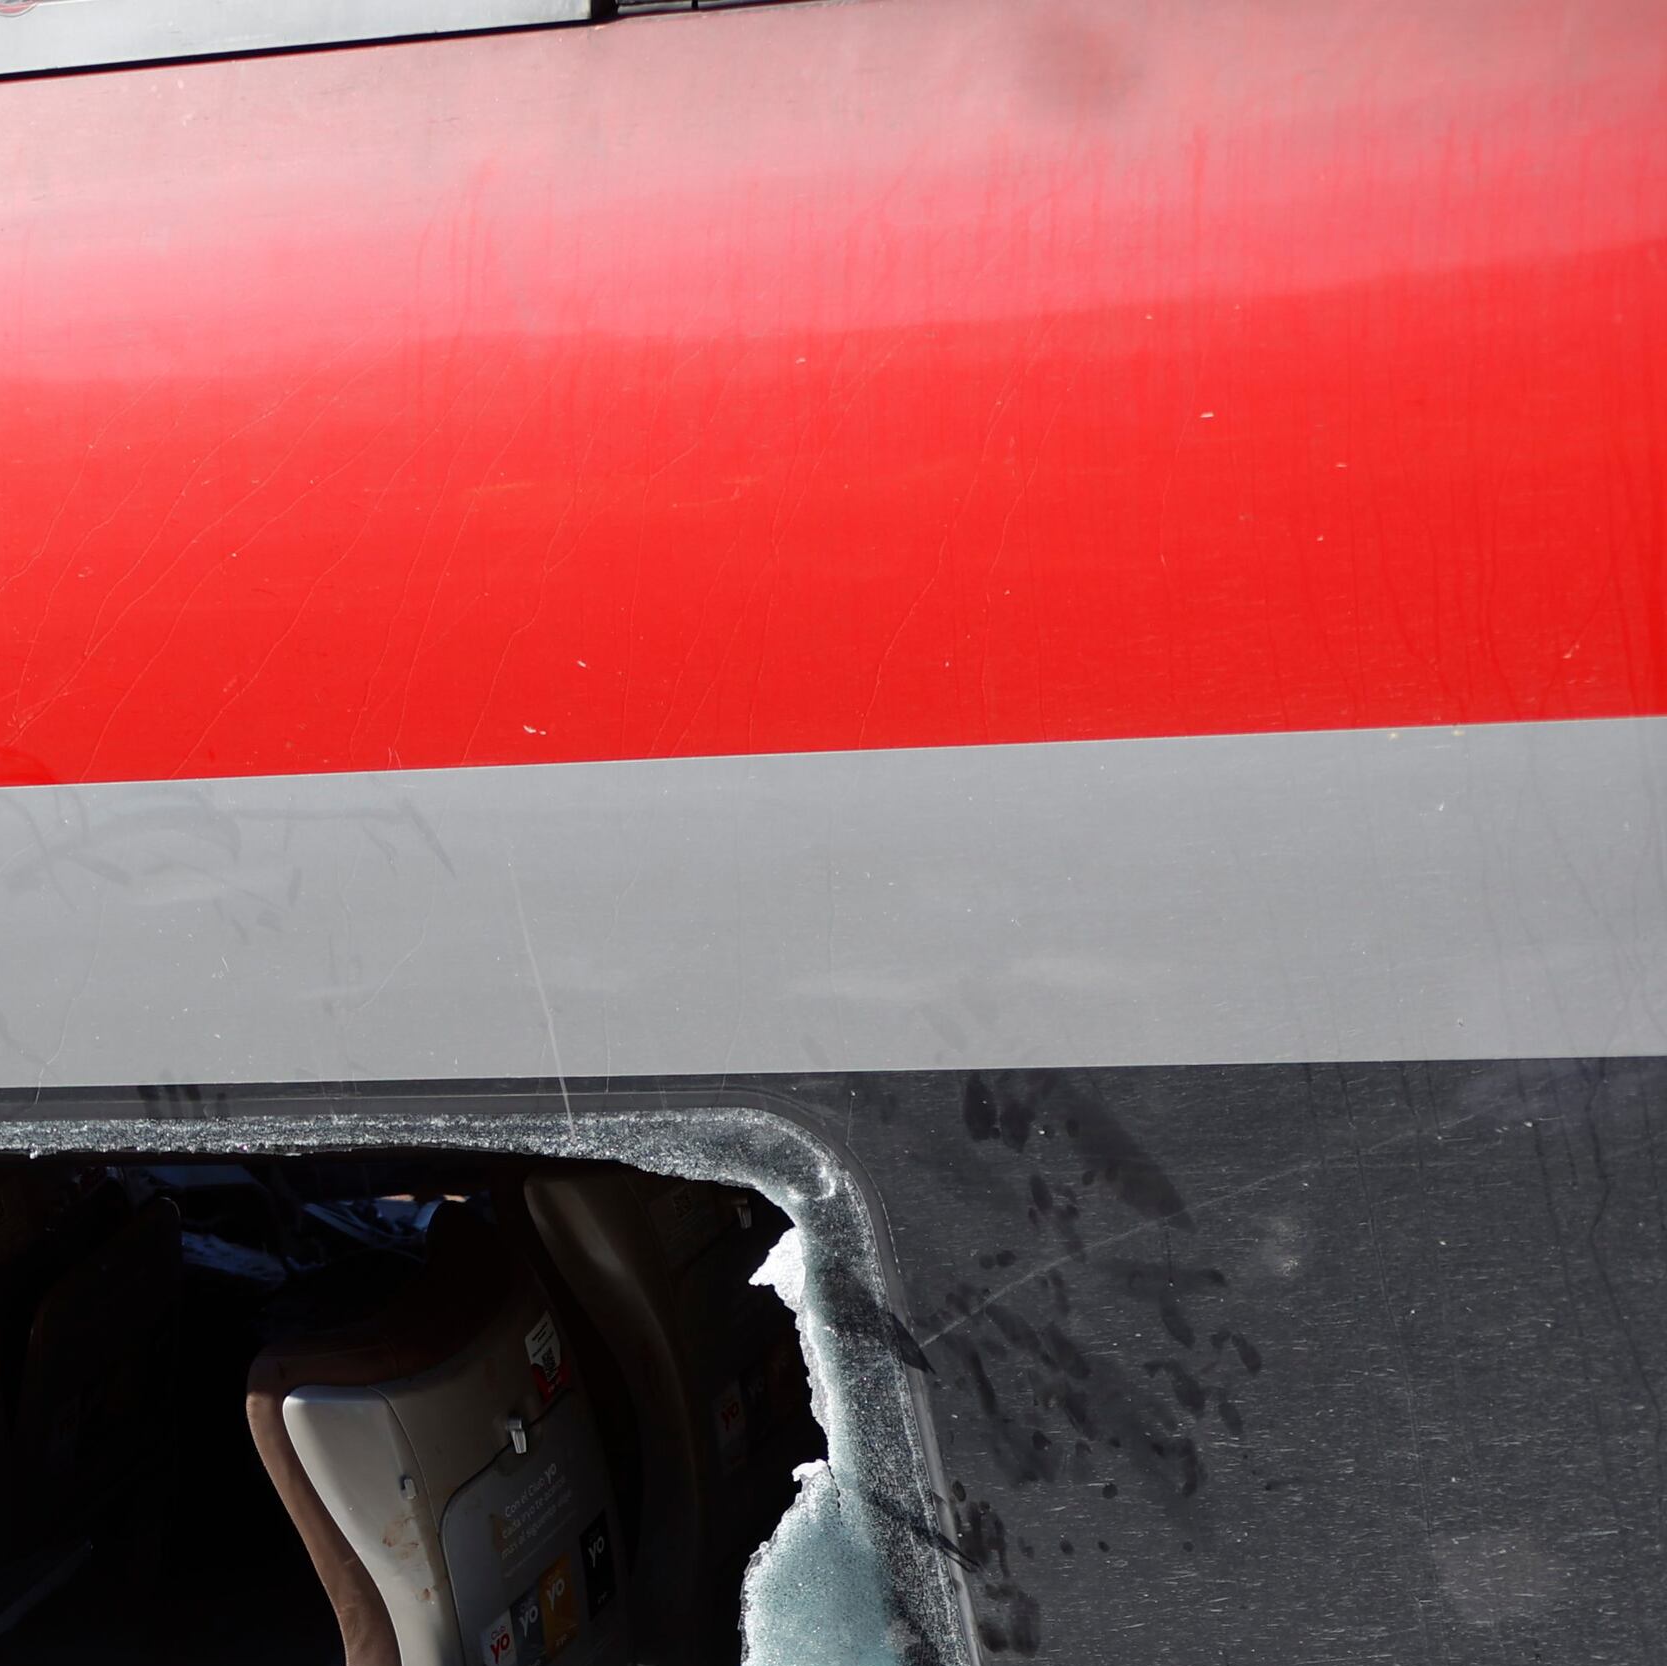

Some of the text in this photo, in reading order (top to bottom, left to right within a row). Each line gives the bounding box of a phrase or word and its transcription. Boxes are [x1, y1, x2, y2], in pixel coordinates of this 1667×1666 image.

[505, 1499, 521, 1518] Con
[544, 1463, 557, 1485] yo
[588, 1535, 605, 1569] yo
[546, 1578, 565, 1612] yo
[519, 1604, 538, 1639] yo
[491, 1633, 510, 1664] yo
